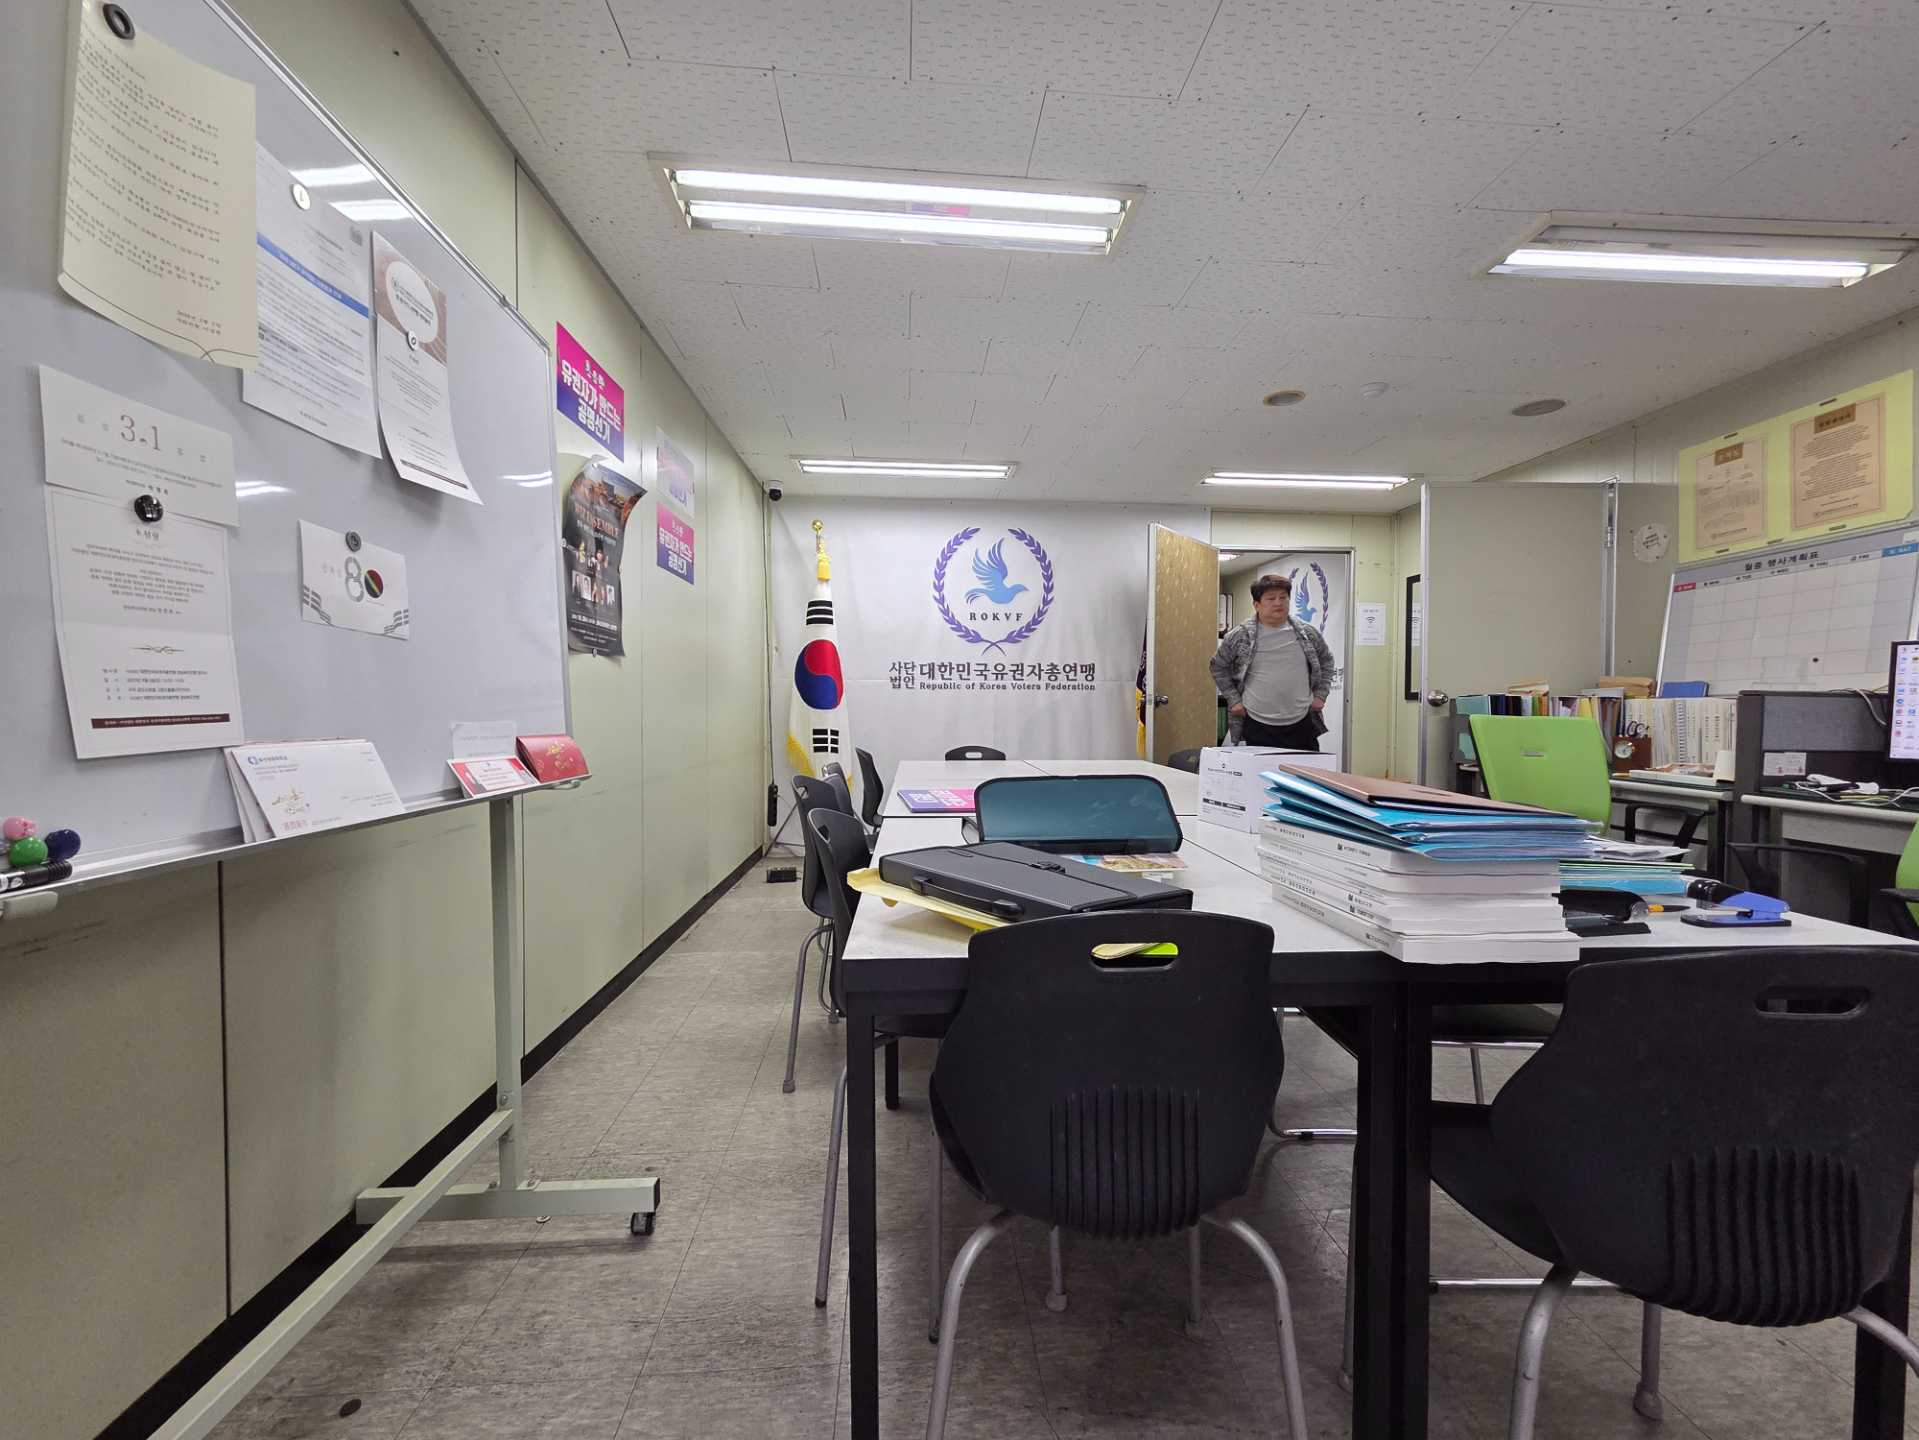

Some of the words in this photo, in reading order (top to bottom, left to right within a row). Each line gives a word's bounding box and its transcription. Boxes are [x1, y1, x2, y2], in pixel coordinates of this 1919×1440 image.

[561, 359, 598, 409] 유권자가
[599, 393, 621, 432] 만드는
[578, 398, 611, 444] 공명선거
[574, 502, 586, 520] WIZ
[586, 510, 620, 539] ENSEMBLE
[659, 526, 679, 553] 유권자가
[679, 538, 692, 562] 만드는
[668, 550, 686, 576] 공명선거
[1744, 561, 1762, 571] 월중
[1767, 551, 1819, 567] 행사계획표
[969, 612, 1023, 621] ROKVF
[888, 662, 916, 676] 사단
[919, 662, 1096, 682] 대한민국유권자총연맹
[889, 676, 915, 690] 법인
[919, 683, 961, 691] Republic
